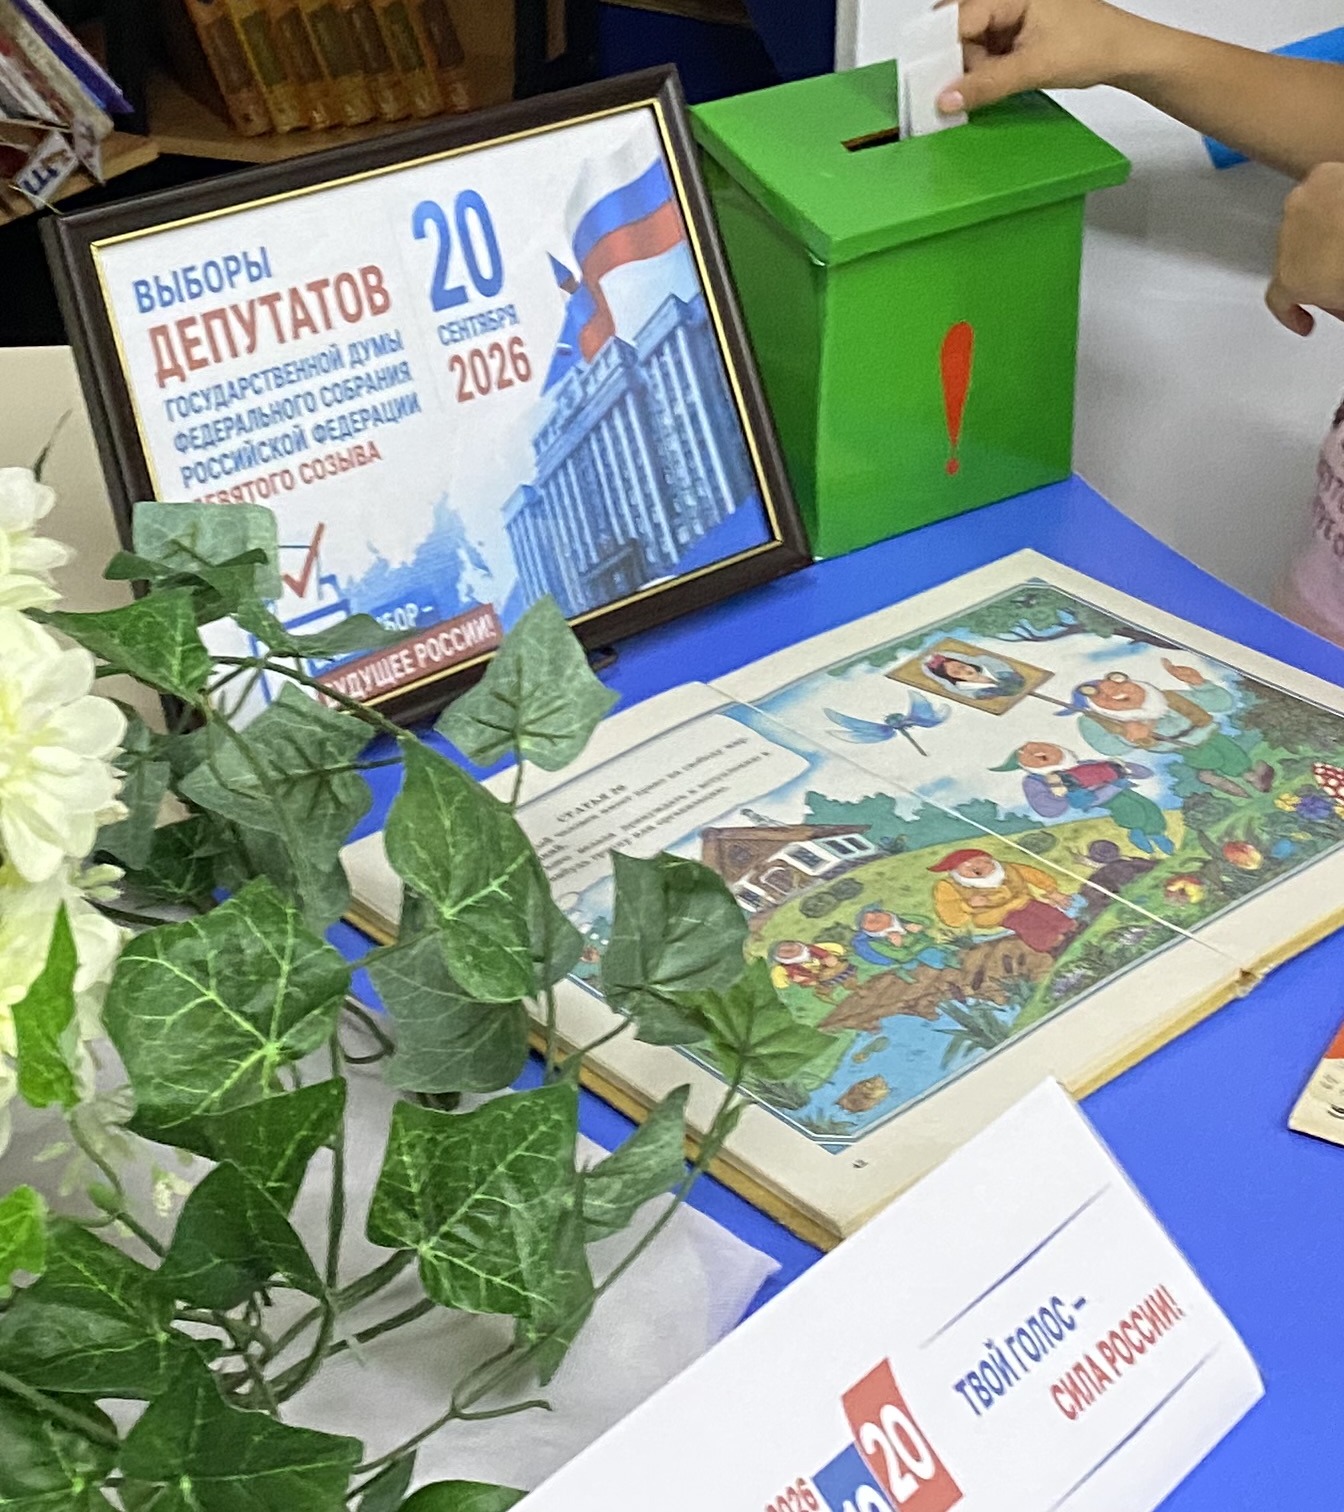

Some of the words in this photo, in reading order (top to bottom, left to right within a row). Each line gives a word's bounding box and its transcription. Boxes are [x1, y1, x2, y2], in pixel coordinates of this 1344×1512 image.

[133, 246, 273, 314] ВЫБОРЫ
[412, 189, 504, 312] 20
[148, 264, 392, 388] ДЕПУТАТОВ
[436, 304, 520, 346] СЕНТЯБРЯ
[448, 335, 532, 403] 2026
[163, 343, 344, 423] ГОСУДАРСТВЕННОЙ
[347, 328, 405, 370] ДУМЫ
[173, 388, 316, 454] ФЕДЕРАЛЬНОГО
[320, 360, 413, 407] СОБРАНИЯ
[179, 423, 309, 489] РОССИЙСКОЙ
[311, 391, 422, 446] ФЕДЕРАЦИИ
[193, 468, 295, 504] ВЯТОГО
[299, 440, 383, 485] СОЗЫВА
[415, 613, 498, 669] РОССИИ!
[953, 1338, 1015, 1416] ТВОЙ
[1005, 1295, 1078, 1383] ГОЛОС
[1050, 1354, 1109, 1422] СИЛА
[1096, 1284, 1186, 1377] РОССИИ!
[859, 1403, 937, 1499] 20
